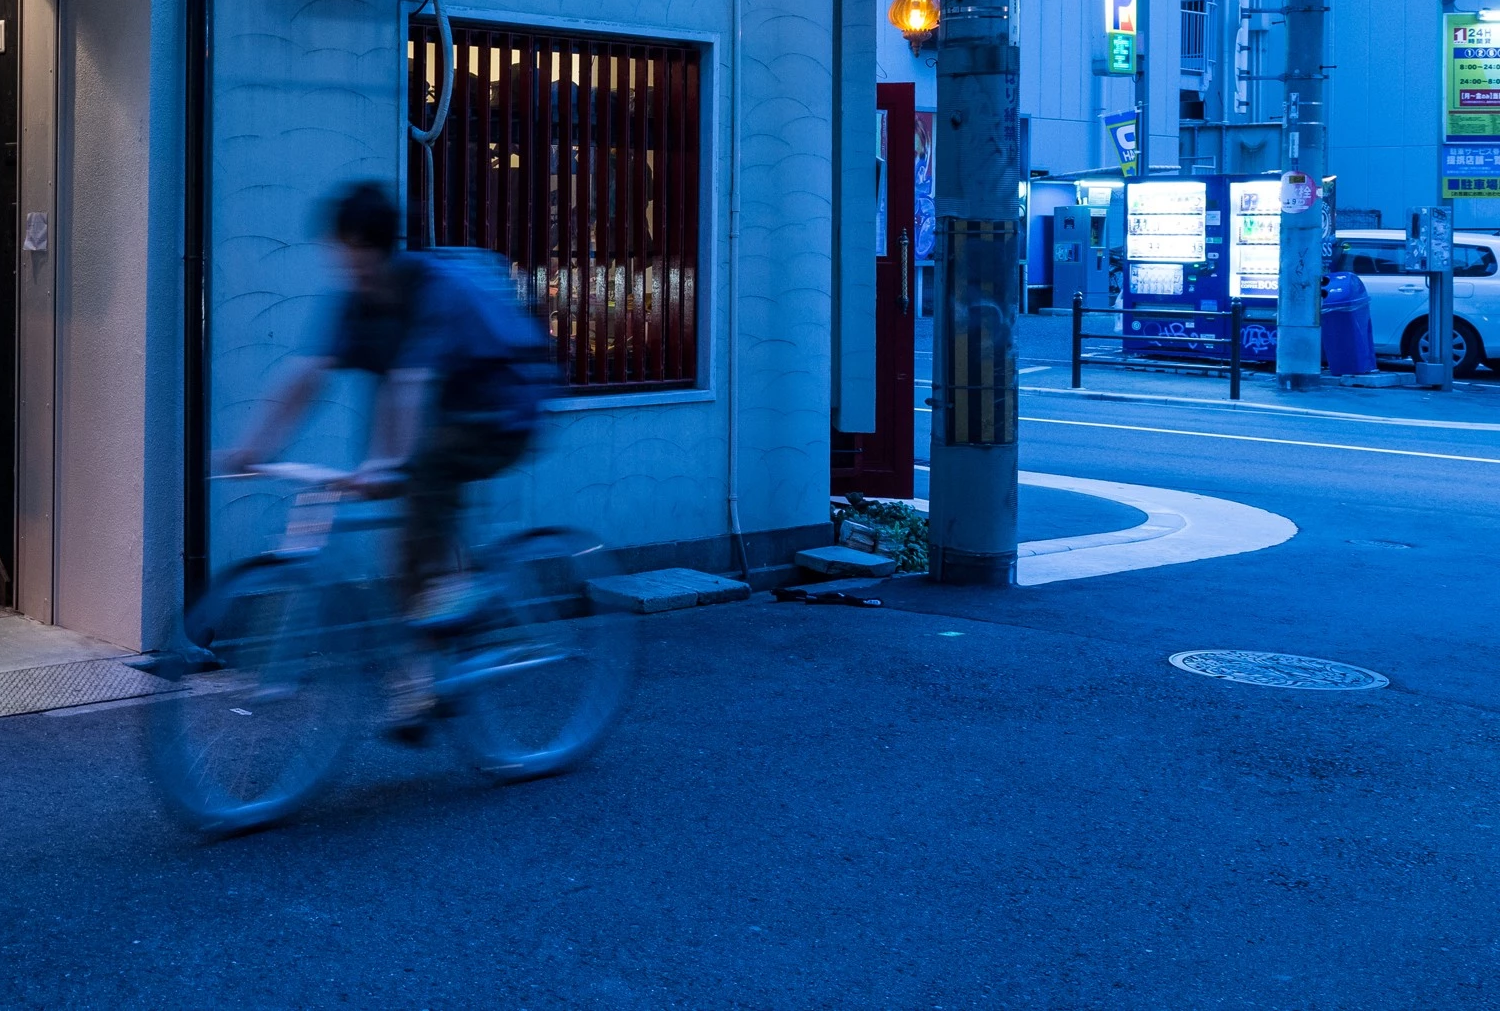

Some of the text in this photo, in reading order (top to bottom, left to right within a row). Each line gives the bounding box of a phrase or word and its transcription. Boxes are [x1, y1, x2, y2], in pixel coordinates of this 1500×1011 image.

[1468, 28, 1492, 38] 24H
[1461, 178, 1500, 191] 駐車場
